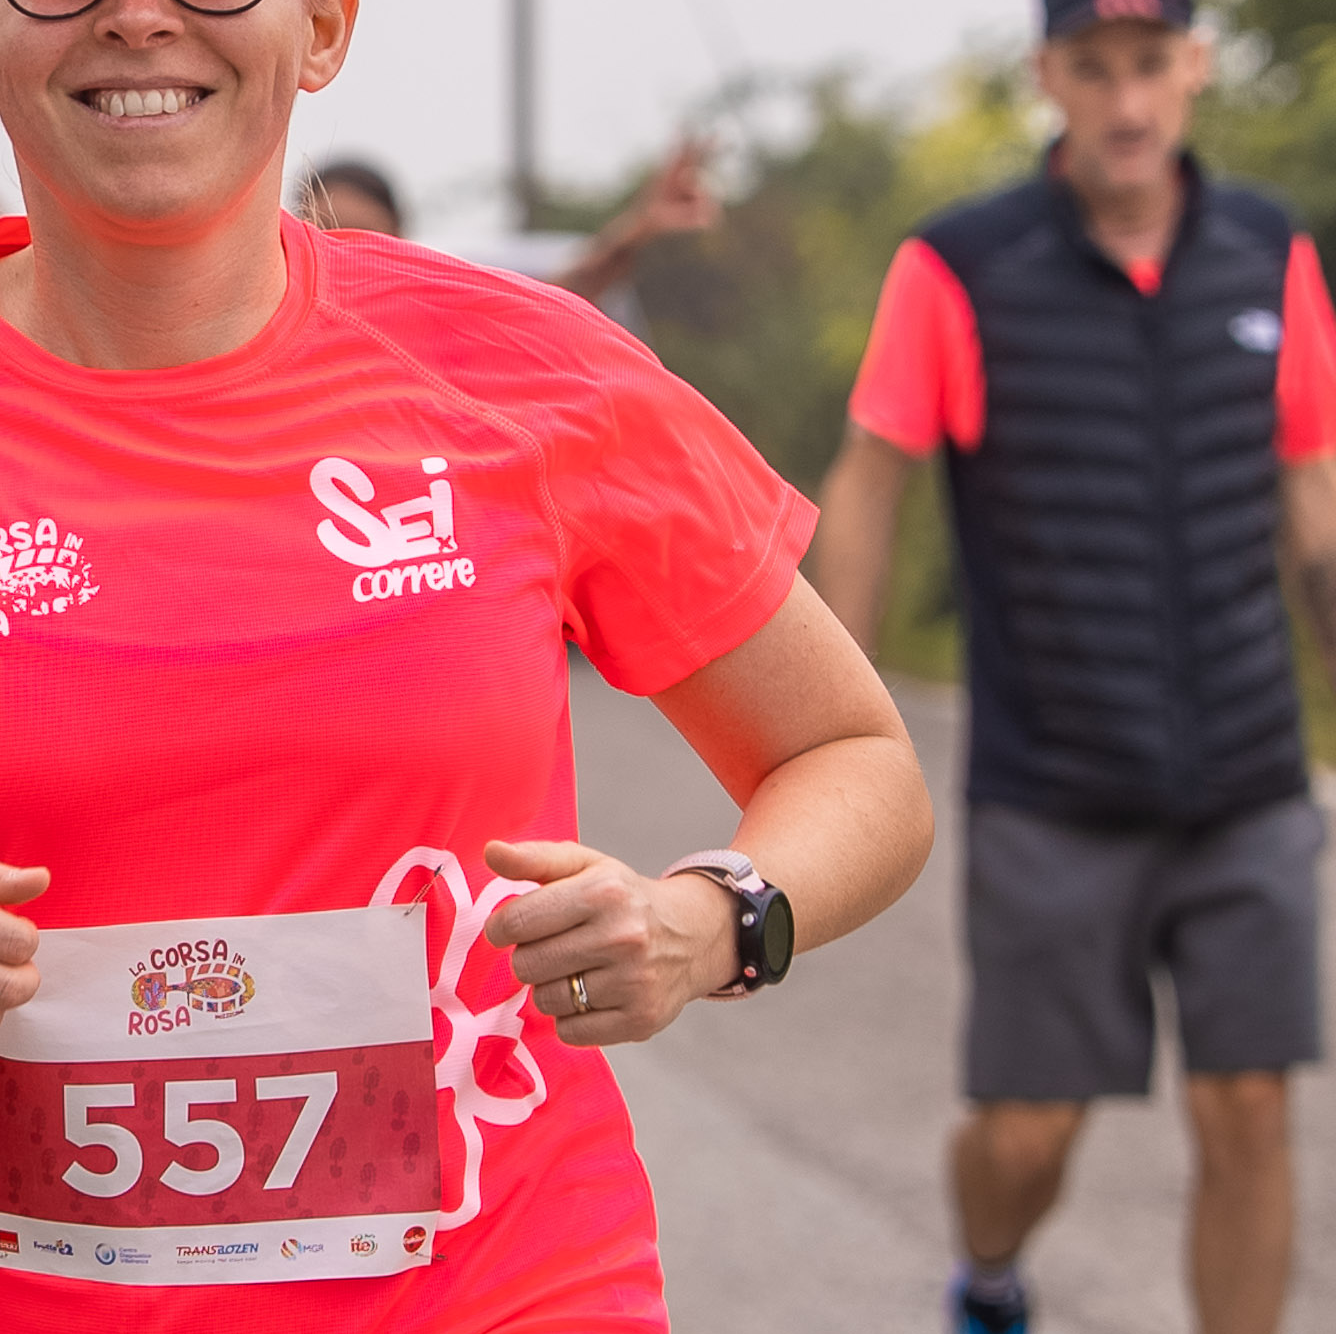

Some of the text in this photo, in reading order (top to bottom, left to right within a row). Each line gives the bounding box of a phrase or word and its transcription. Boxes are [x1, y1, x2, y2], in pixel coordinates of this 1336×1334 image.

[64, 532, 83, 551] IN
[353, 557, 476, 602] correre
[129, 939, 246, 977] LA CORSA IN
[128, 1006, 191, 1035] ROSA
[62, 1071, 338, 1198] 557
[176, 1243, 259, 1256] TRANSBOZEN
